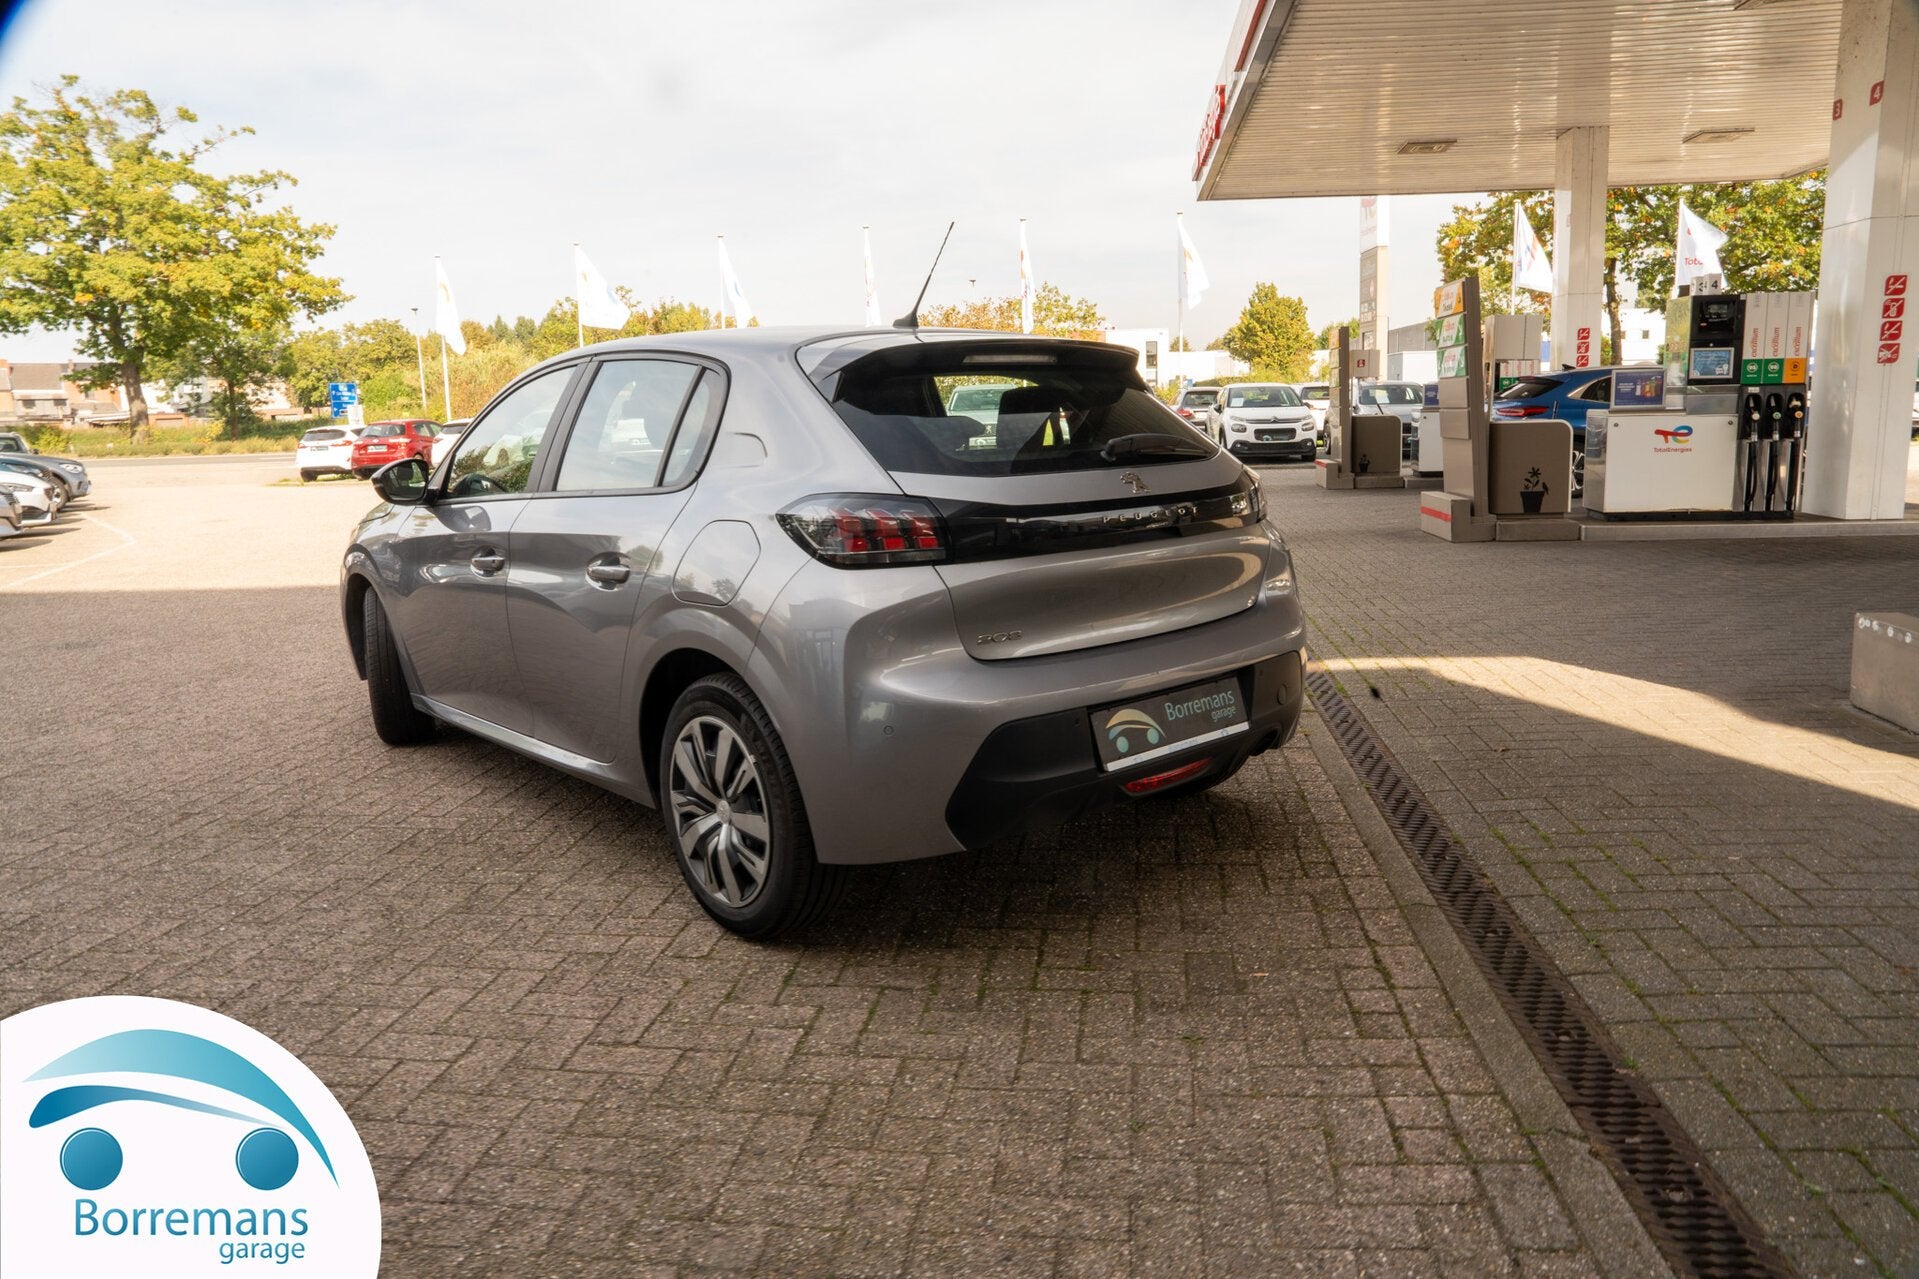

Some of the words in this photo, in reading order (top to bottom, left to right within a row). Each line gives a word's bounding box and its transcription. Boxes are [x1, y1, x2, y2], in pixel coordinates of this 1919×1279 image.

[1873, 86, 1880, 100] 4
[1835, 103, 1841, 117] 3
[1711, 280, 1719, 290] 4
[1103, 506, 1198, 523] PEUGEOT
[976, 630, 1022, 646] 208
[1164, 690, 1235, 721] Borremans
[1211, 705, 1237, 722] garage
